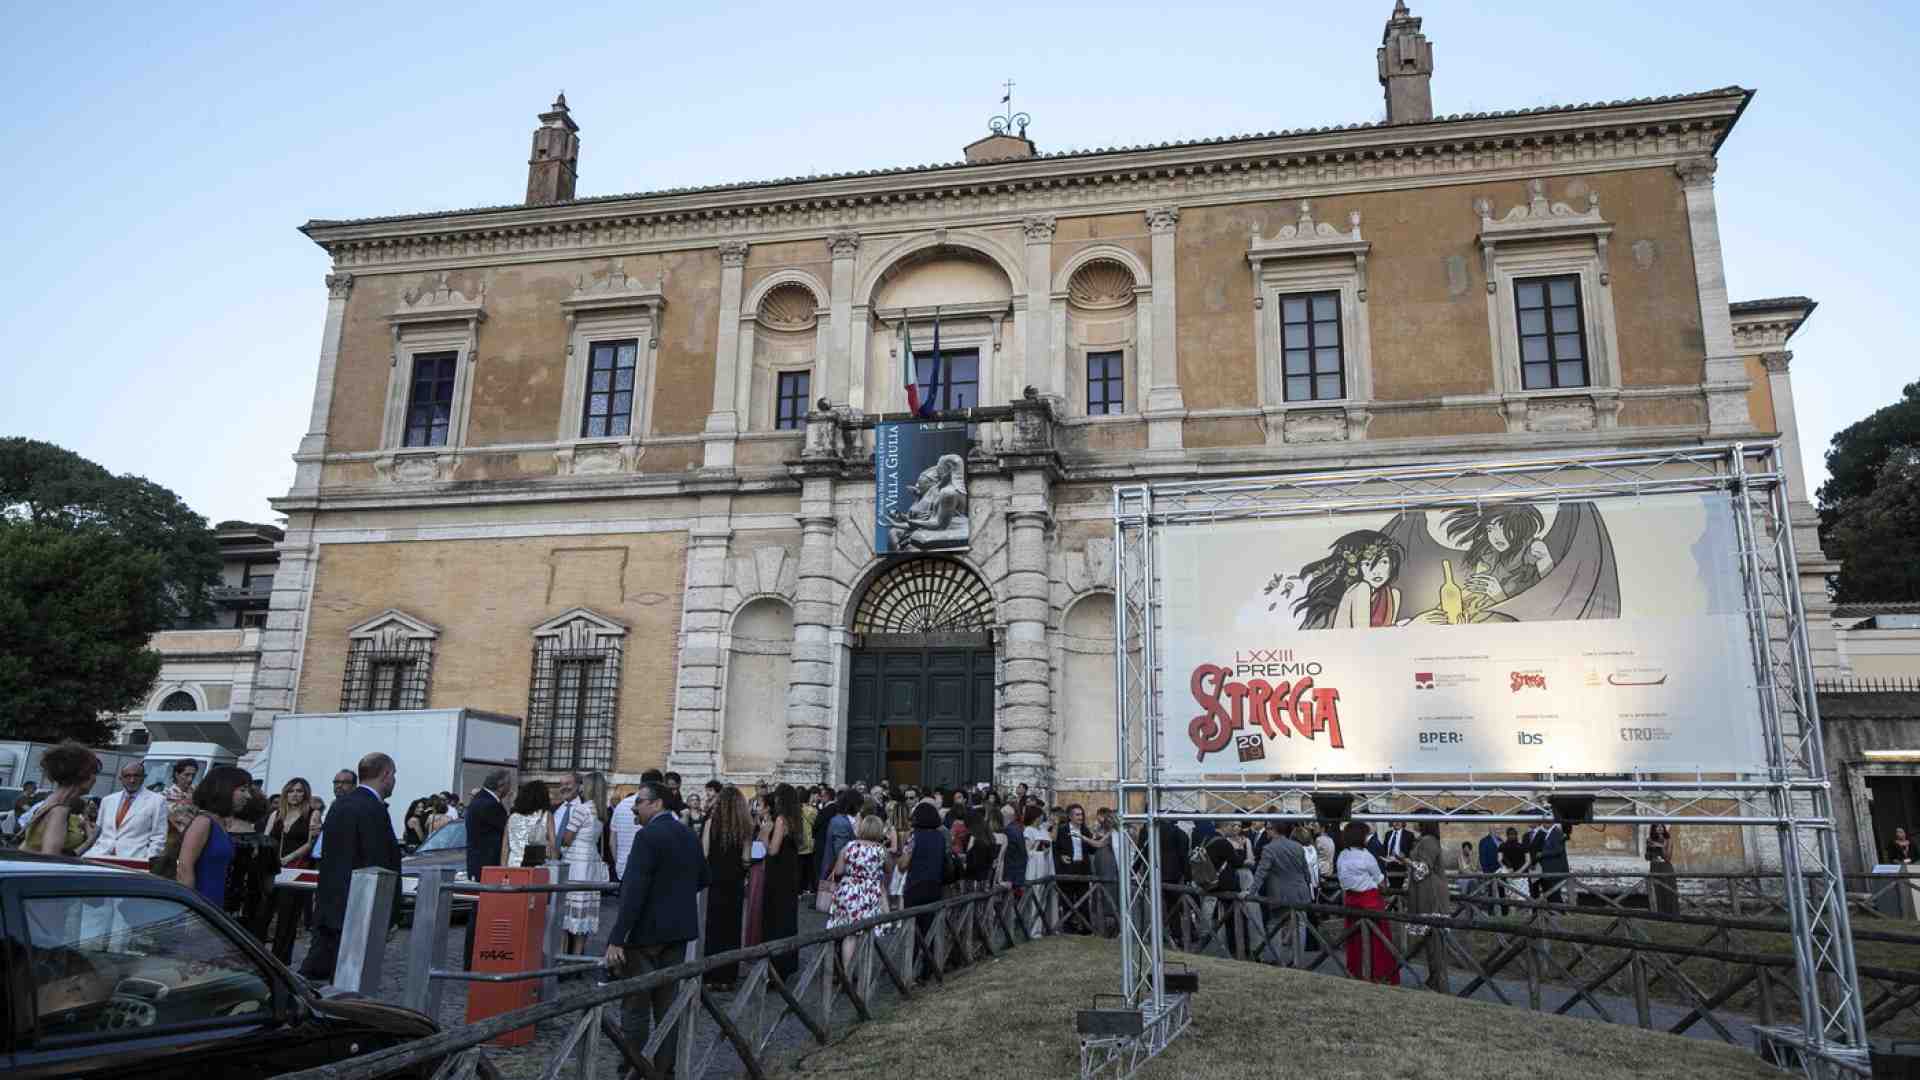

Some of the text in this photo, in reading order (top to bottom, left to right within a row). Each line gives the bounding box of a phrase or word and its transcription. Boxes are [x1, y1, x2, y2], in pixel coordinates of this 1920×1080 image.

[885, 425, 899, 508] VILLA GIULIA
[1236, 649, 1293, 663] LXXIII
[1236, 662, 1322, 677] PREMIO
[1188, 663, 1345, 762] STREGA
[1518, 731, 1543, 745] ibs
[1620, 727, 1652, 741] ETRO
